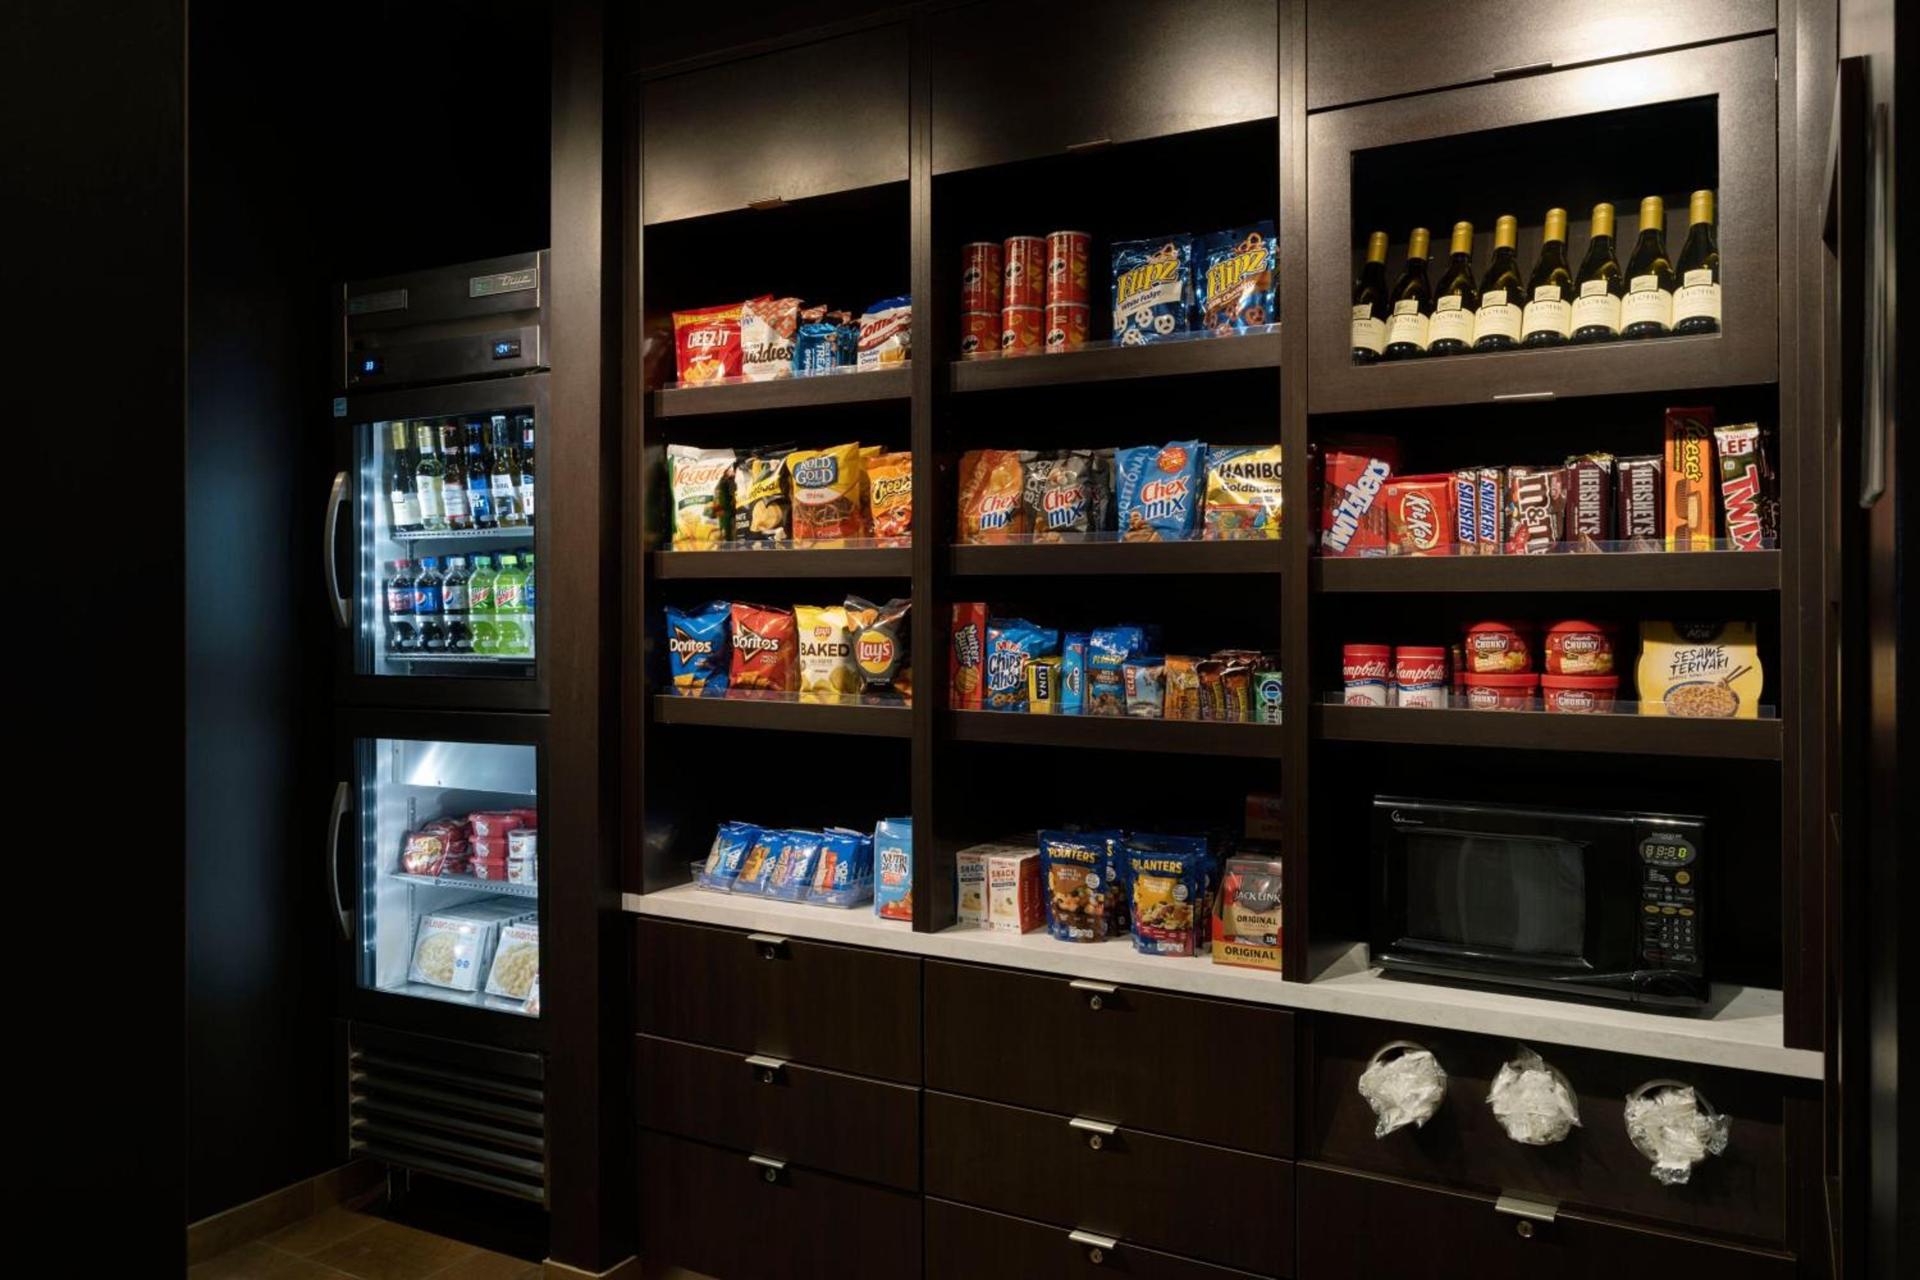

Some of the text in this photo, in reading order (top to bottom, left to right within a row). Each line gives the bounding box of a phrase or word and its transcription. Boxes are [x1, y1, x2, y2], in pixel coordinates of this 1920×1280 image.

[1118, 260, 1180, 303] Flipz
[1207, 250, 1267, 299] Flipz
[801, 456, 831, 470] ROLD
[796, 468, 833, 485] GOLD
[1044, 487, 1083, 511] Chex
[1141, 475, 1191, 502] Chex
[979, 493, 1020, 513] Chex
[1145, 494, 1186, 519] mix
[1459, 481, 1475, 542] SATISFIES
[1481, 479, 1496, 541] SNICKERS
[1579, 469, 1600, 534] HERSHEY'S
[1632, 468, 1655, 535] HERSHEY'S
[1722, 464, 1762, 550] TWIX
[981, 506, 1015, 529] mix
[1048, 502, 1083, 528] mix
[670, 638, 712, 653] Doritos
[733, 634, 778, 650] Doritos
[801, 643, 850, 657] BAKED
[860, 640, 891, 663] Lay's
[955, 630, 971, 667] Butter
[965, 624, 980, 663] Nutter
[1475, 638, 1508, 650] CHUNKY
[1564, 639, 1599, 650] CHUNKY
[989, 653, 1020, 676] Chips
[1673, 644, 1727, 664] SESAME
[1670, 657, 1729, 675] TERIYAKI
[1038, 667, 1048, 697] LUNA
[1558, 697, 1592, 707] CHUNKY
[1048, 846, 1097, 863] PLANTERS
[960, 864, 985, 873] SNACK
[991, 870, 1016, 878] SNACK
[1132, 859, 1183, 873] PLANTERS
[1236, 915, 1278, 925] ORIGINAL
[1224, 945, 1276, 960] ORIGINAL
